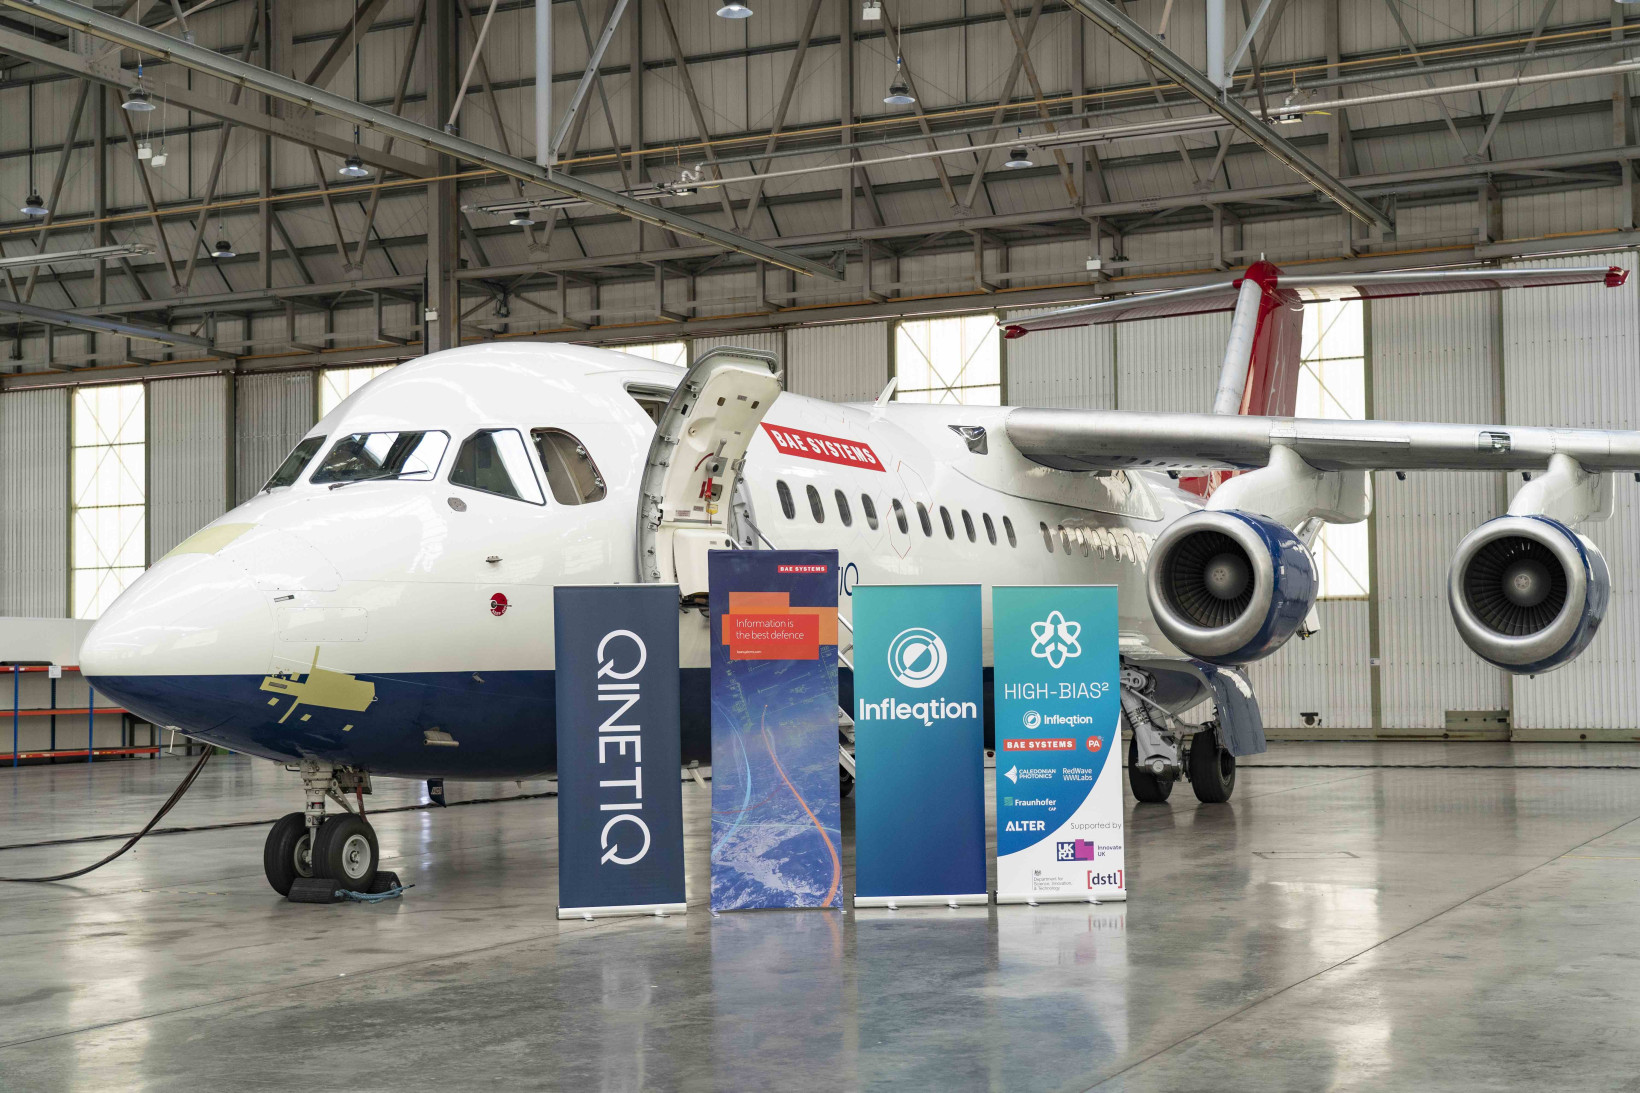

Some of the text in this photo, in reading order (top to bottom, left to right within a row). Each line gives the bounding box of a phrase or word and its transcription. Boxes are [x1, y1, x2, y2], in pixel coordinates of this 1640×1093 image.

[770, 429, 877, 464] BAE SYSTEMS
[736, 619, 794, 628] Information is
[736, 630, 805, 640] the best defence
[859, 697, 977, 726] Infleqtion
[1044, 714, 1093, 727] Infleqtion
[597, 629, 651, 865] QINETIQ
[1006, 740, 1073, 749] BAE SYSTEMS
[1088, 740, 1100, 748] PA
[1014, 798, 1057, 807] Fraunhofer
[1005, 820, 1046, 832] ALTER
[1070, 821, 1122, 830] Supported by
